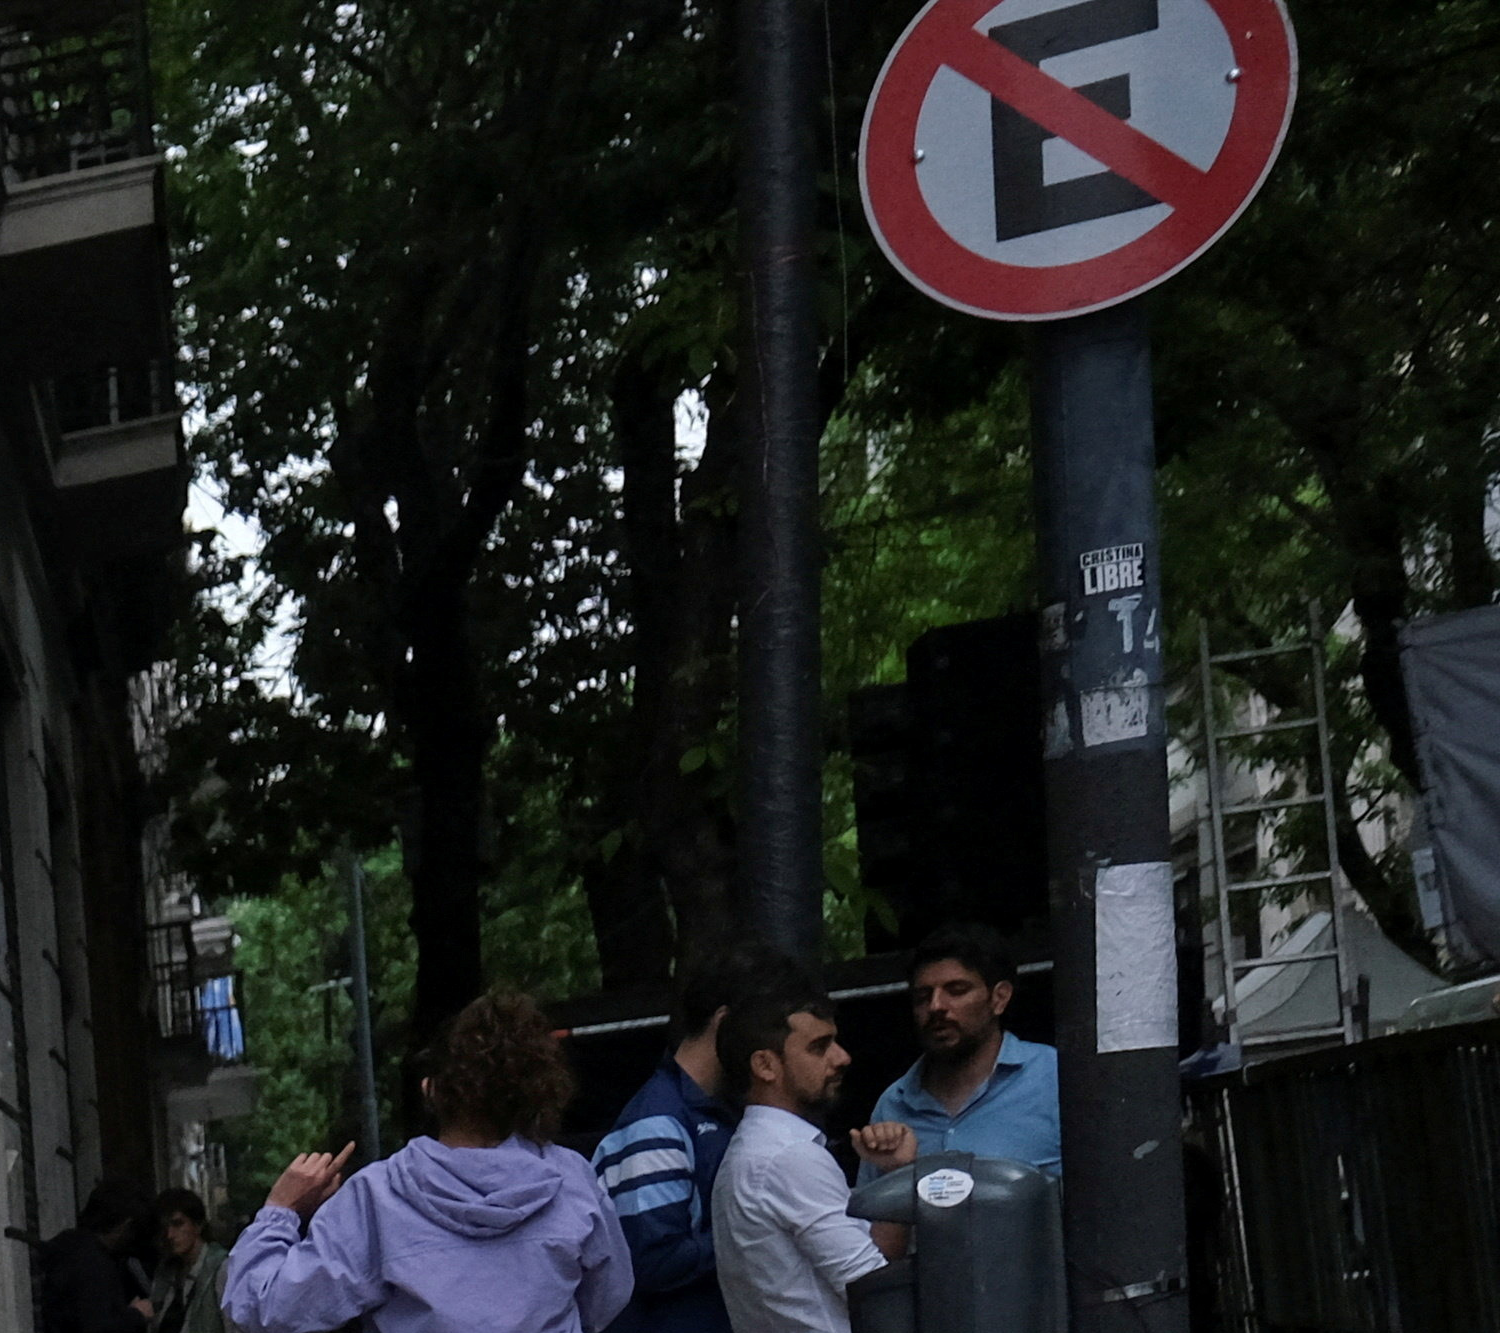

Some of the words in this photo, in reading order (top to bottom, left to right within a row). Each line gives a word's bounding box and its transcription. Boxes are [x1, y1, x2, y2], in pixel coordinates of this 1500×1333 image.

[989, 0, 1175, 242] E
[1081, 544, 1142, 568] CRISTINA
[1084, 559, 1144, 596] LIBRE
